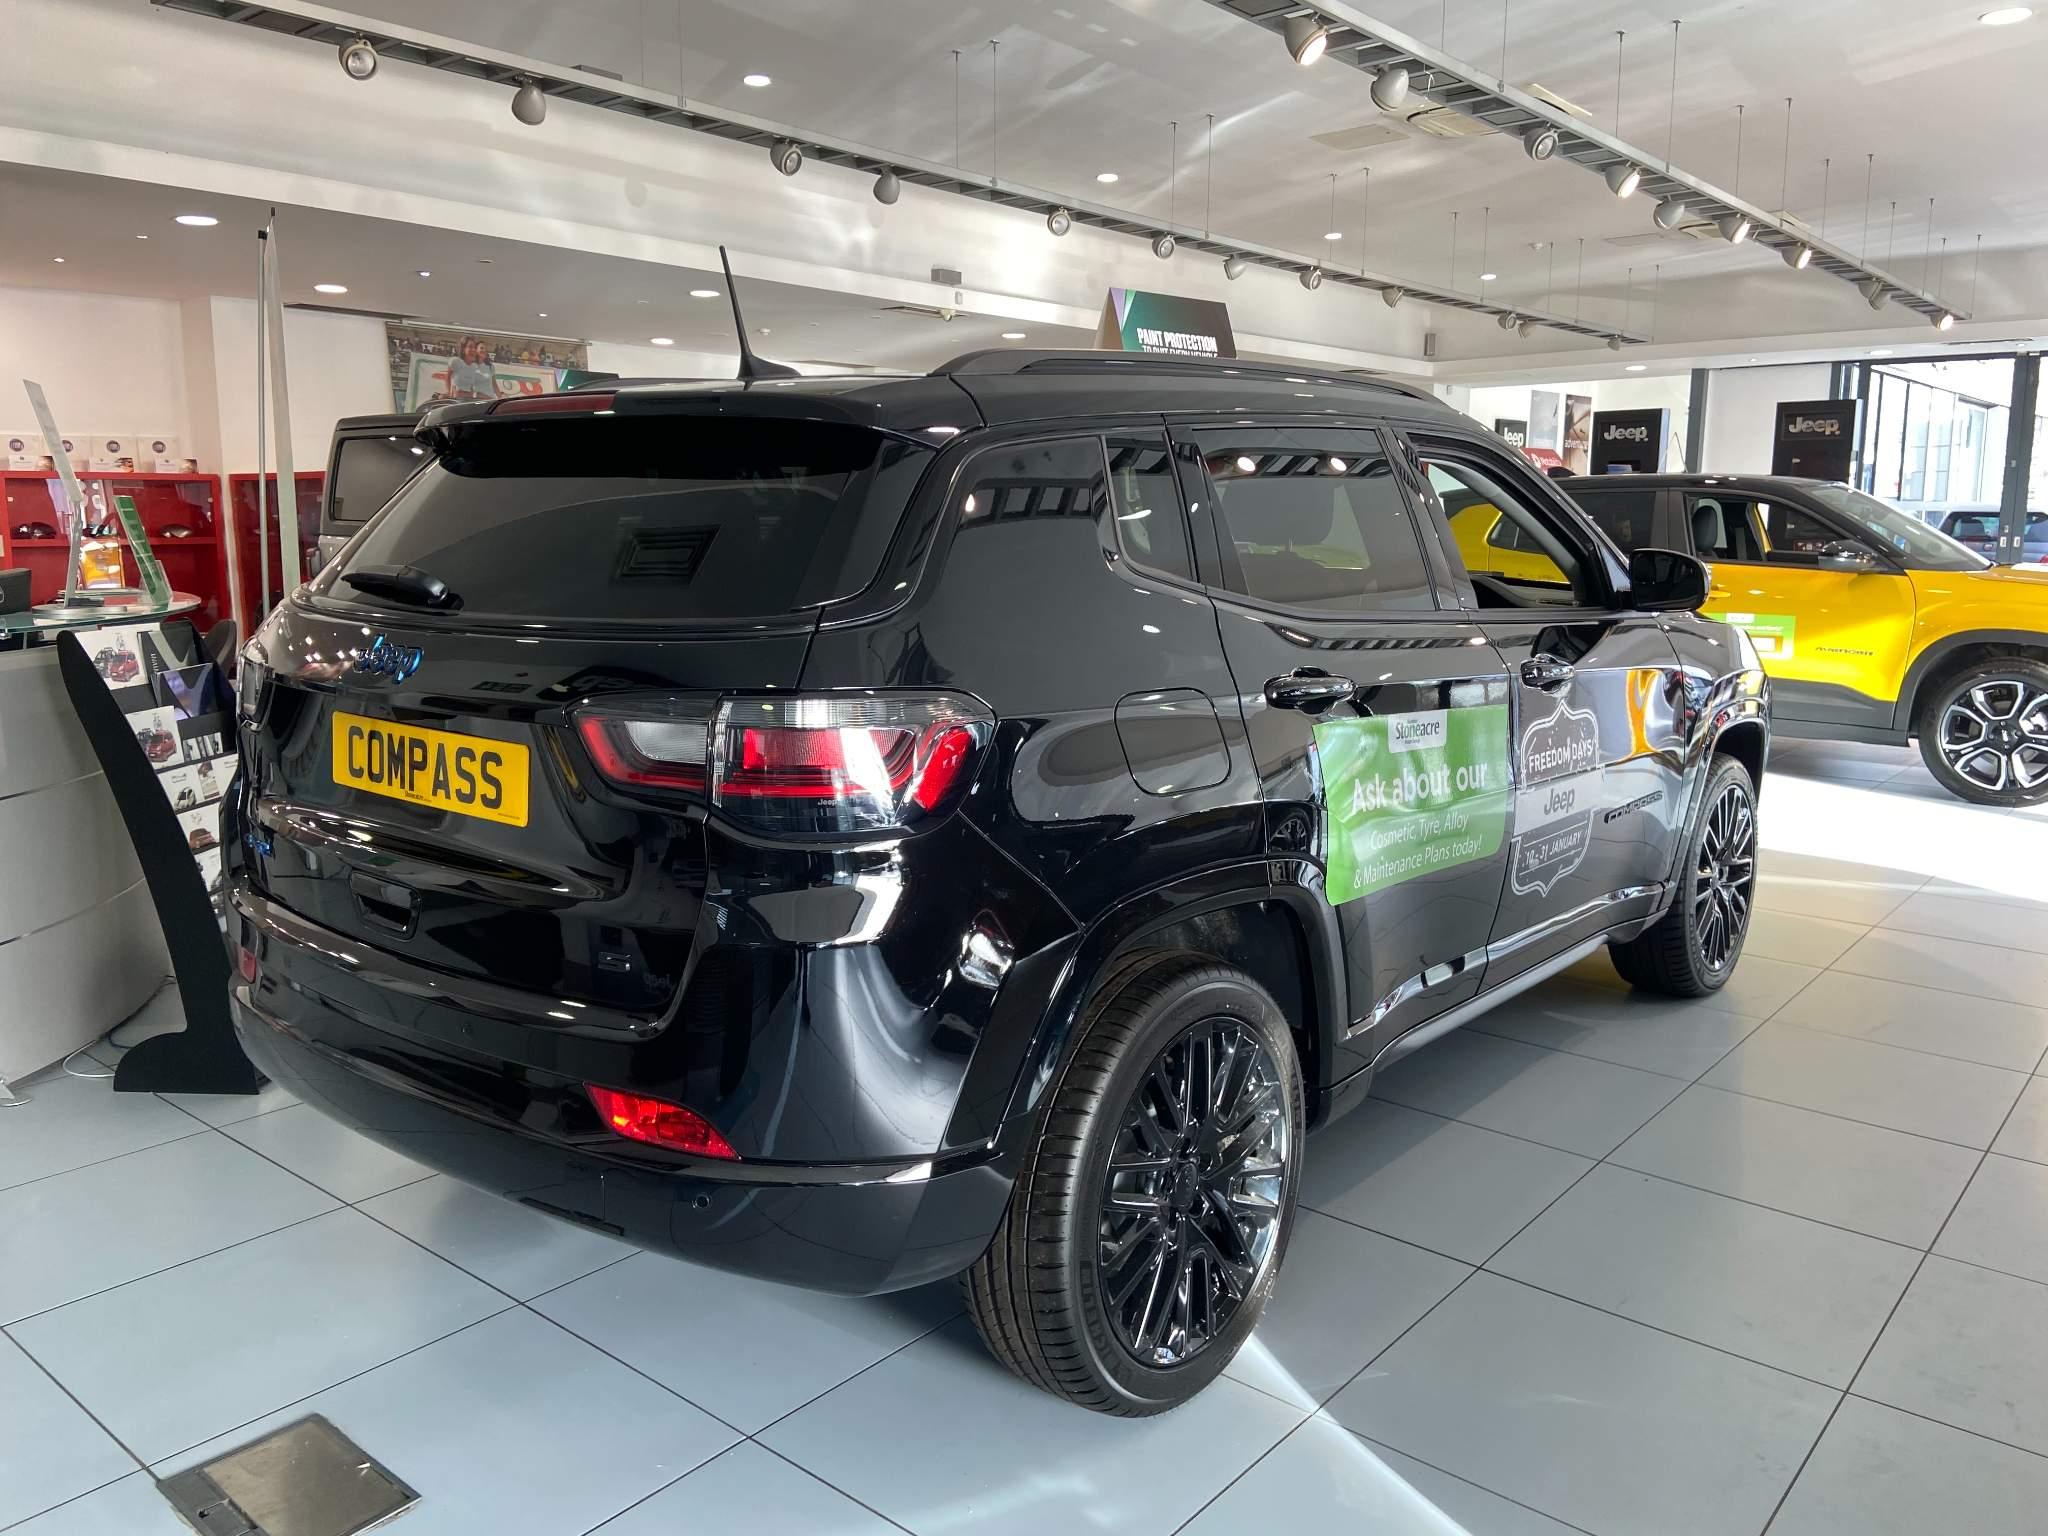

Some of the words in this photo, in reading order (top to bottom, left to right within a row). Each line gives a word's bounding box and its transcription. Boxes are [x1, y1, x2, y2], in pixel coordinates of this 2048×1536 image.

[1136, 328, 1163, 346] PAINT
[1163, 331, 1218, 352] PROTECTION
[1504, 427, 1524, 447] Jeep
[1604, 425, 1648, 442] Jeep
[1789, 416, 1840, 435] Jeep
[1395, 721, 1440, 740] Stoneacre
[348, 726, 503, 809] COMPASS
[1529, 746, 1571, 773] FREEDOM
[1572, 739, 1594, 760] DAYS
[1352, 773, 1387, 813] Ask
[1392, 764, 1451, 806] about
[1456, 762, 1488, 792] our
[1544, 787, 1575, 815] Jeep
[1370, 822, 1416, 850] Cosmetic,
[1444, 811, 1469, 832] Alloy
[1550, 831, 1581, 855] JANUARY
[1353, 869, 1361, 889] &
[1363, 854, 1422, 886] Maintenance
[1425, 845, 1450, 865] Plans
[1452, 834, 1482, 857] today!
